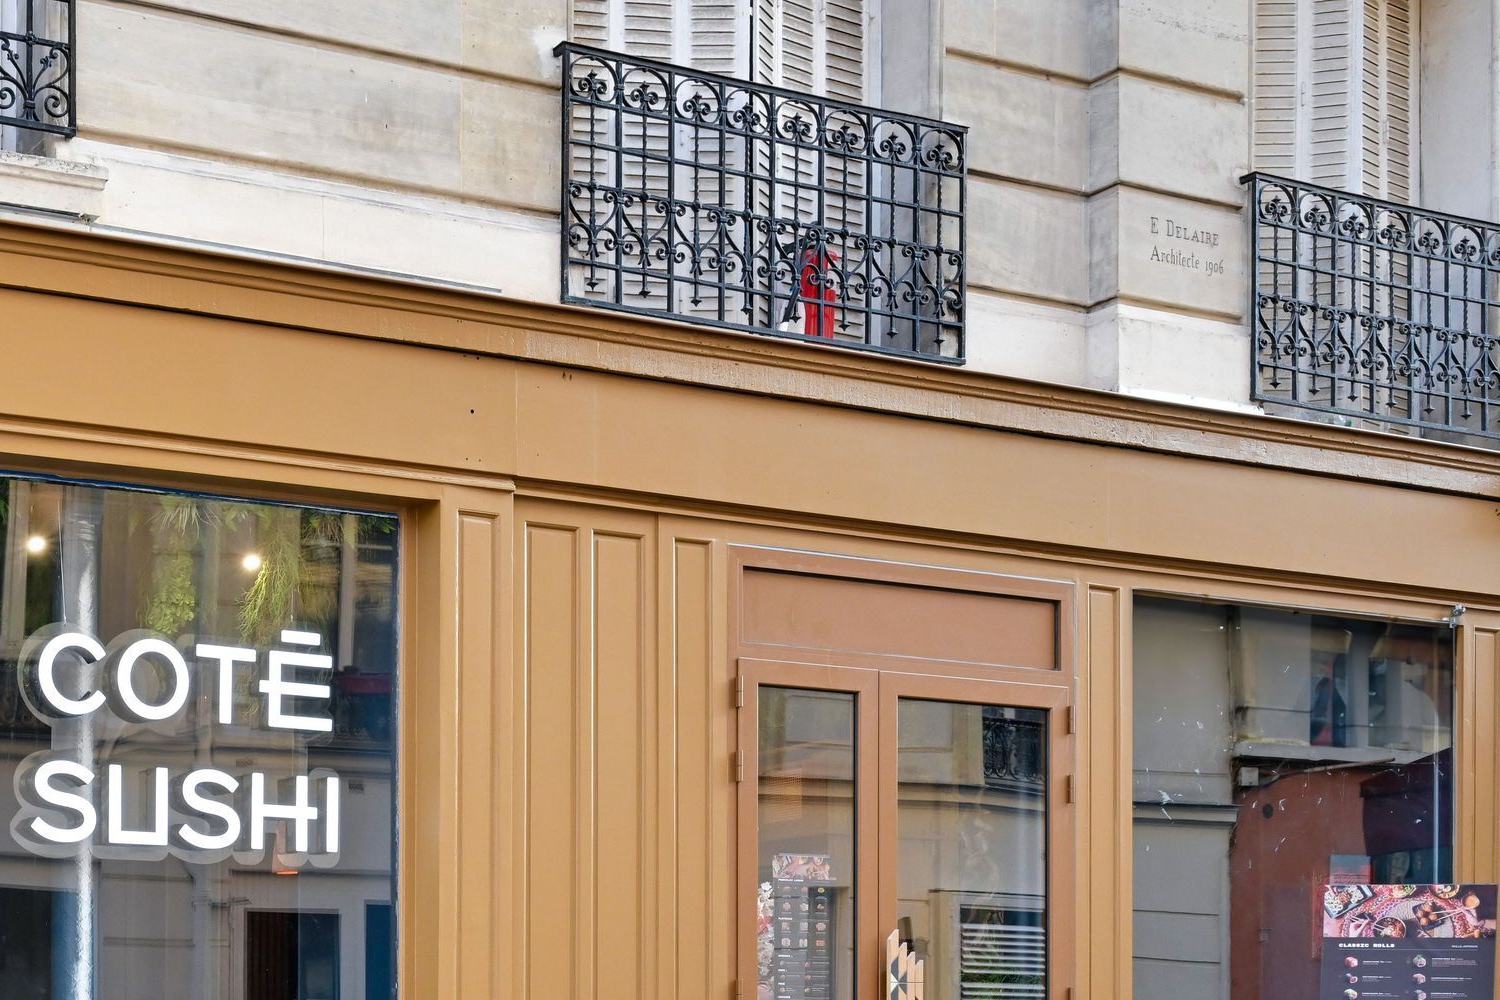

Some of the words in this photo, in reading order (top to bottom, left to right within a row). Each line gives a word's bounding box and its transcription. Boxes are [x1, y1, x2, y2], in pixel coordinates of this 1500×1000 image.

[1150, 245, 1200, 270] Architecte
[1205, 259, 1224, 277] 1906
[30, 759, 340, 853] SUSHI
